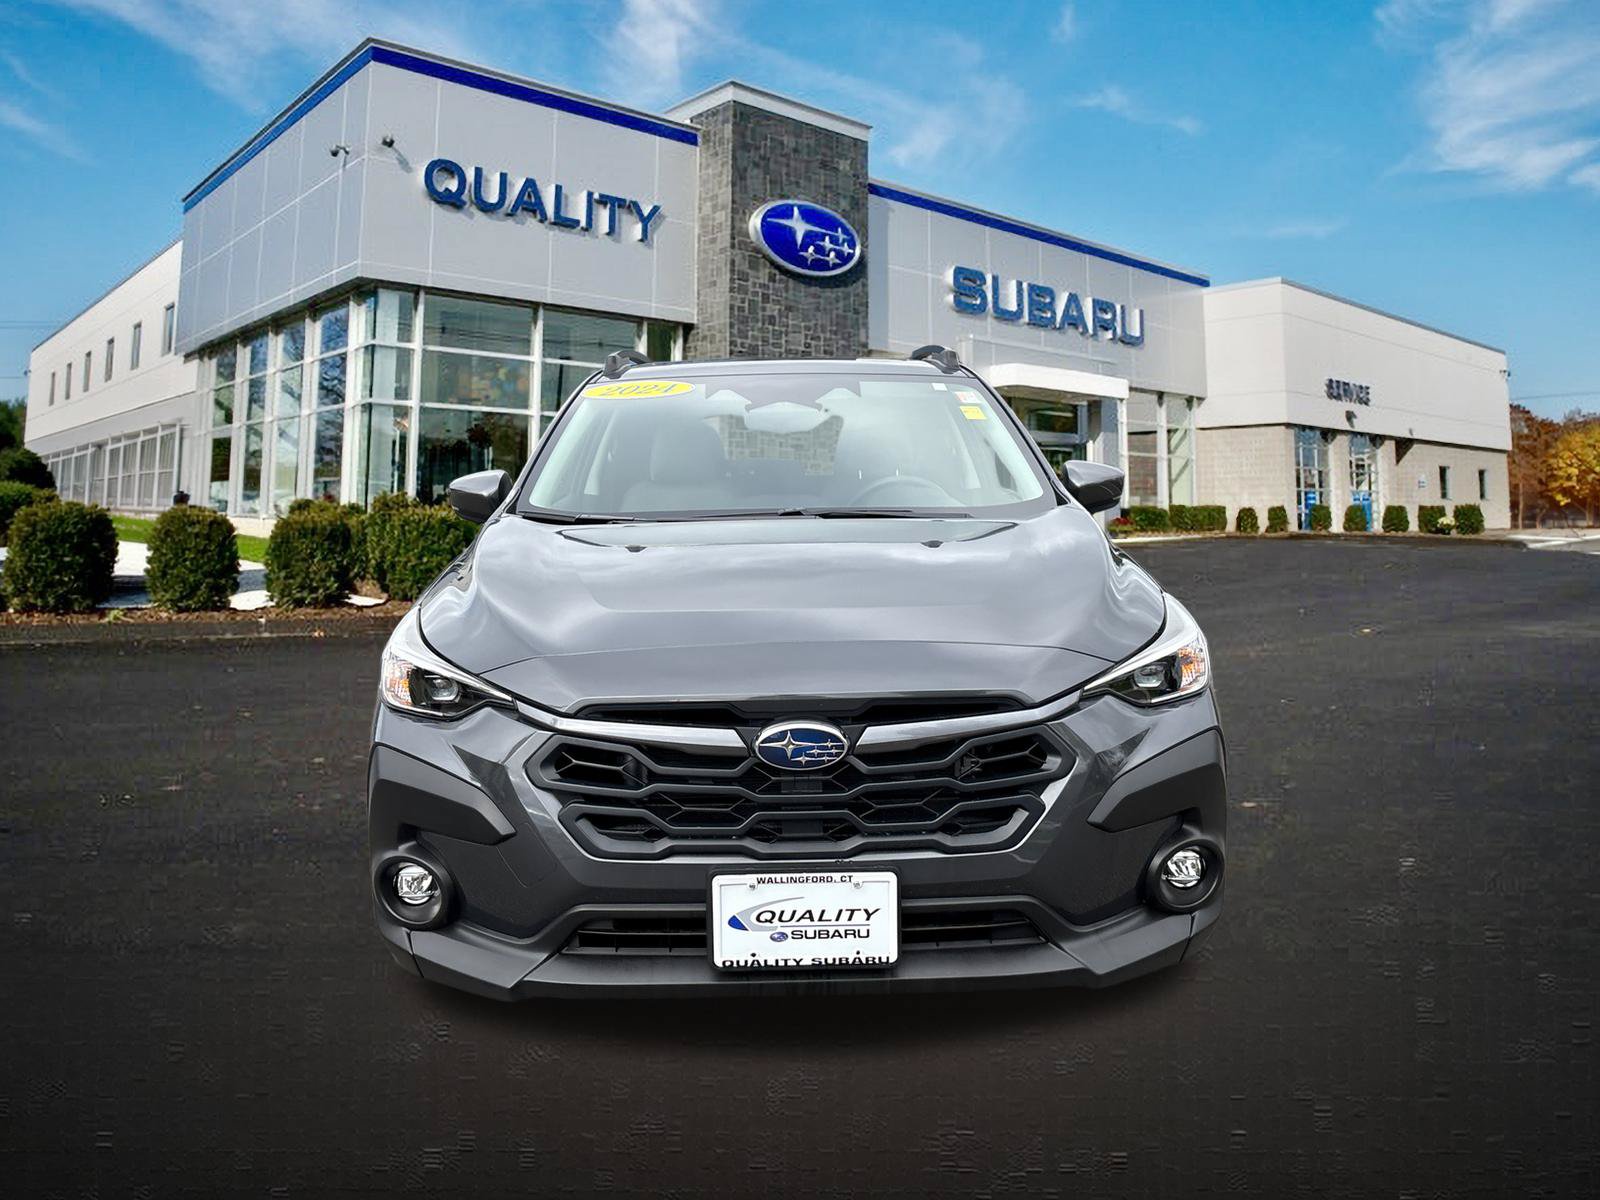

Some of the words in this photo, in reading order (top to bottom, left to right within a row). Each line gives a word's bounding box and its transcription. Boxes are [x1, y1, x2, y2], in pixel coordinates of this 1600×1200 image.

[424, 158, 661, 243] QUALITY
[948, 265, 1145, 347] SUBARU
[840, 875, 853, 883] CT
[755, 908, 881, 923] QUALITY
[791, 929, 870, 939] SUBARU
[722, 957, 804, 968] QUALITY
[811, 956, 890, 966] SUBARU
